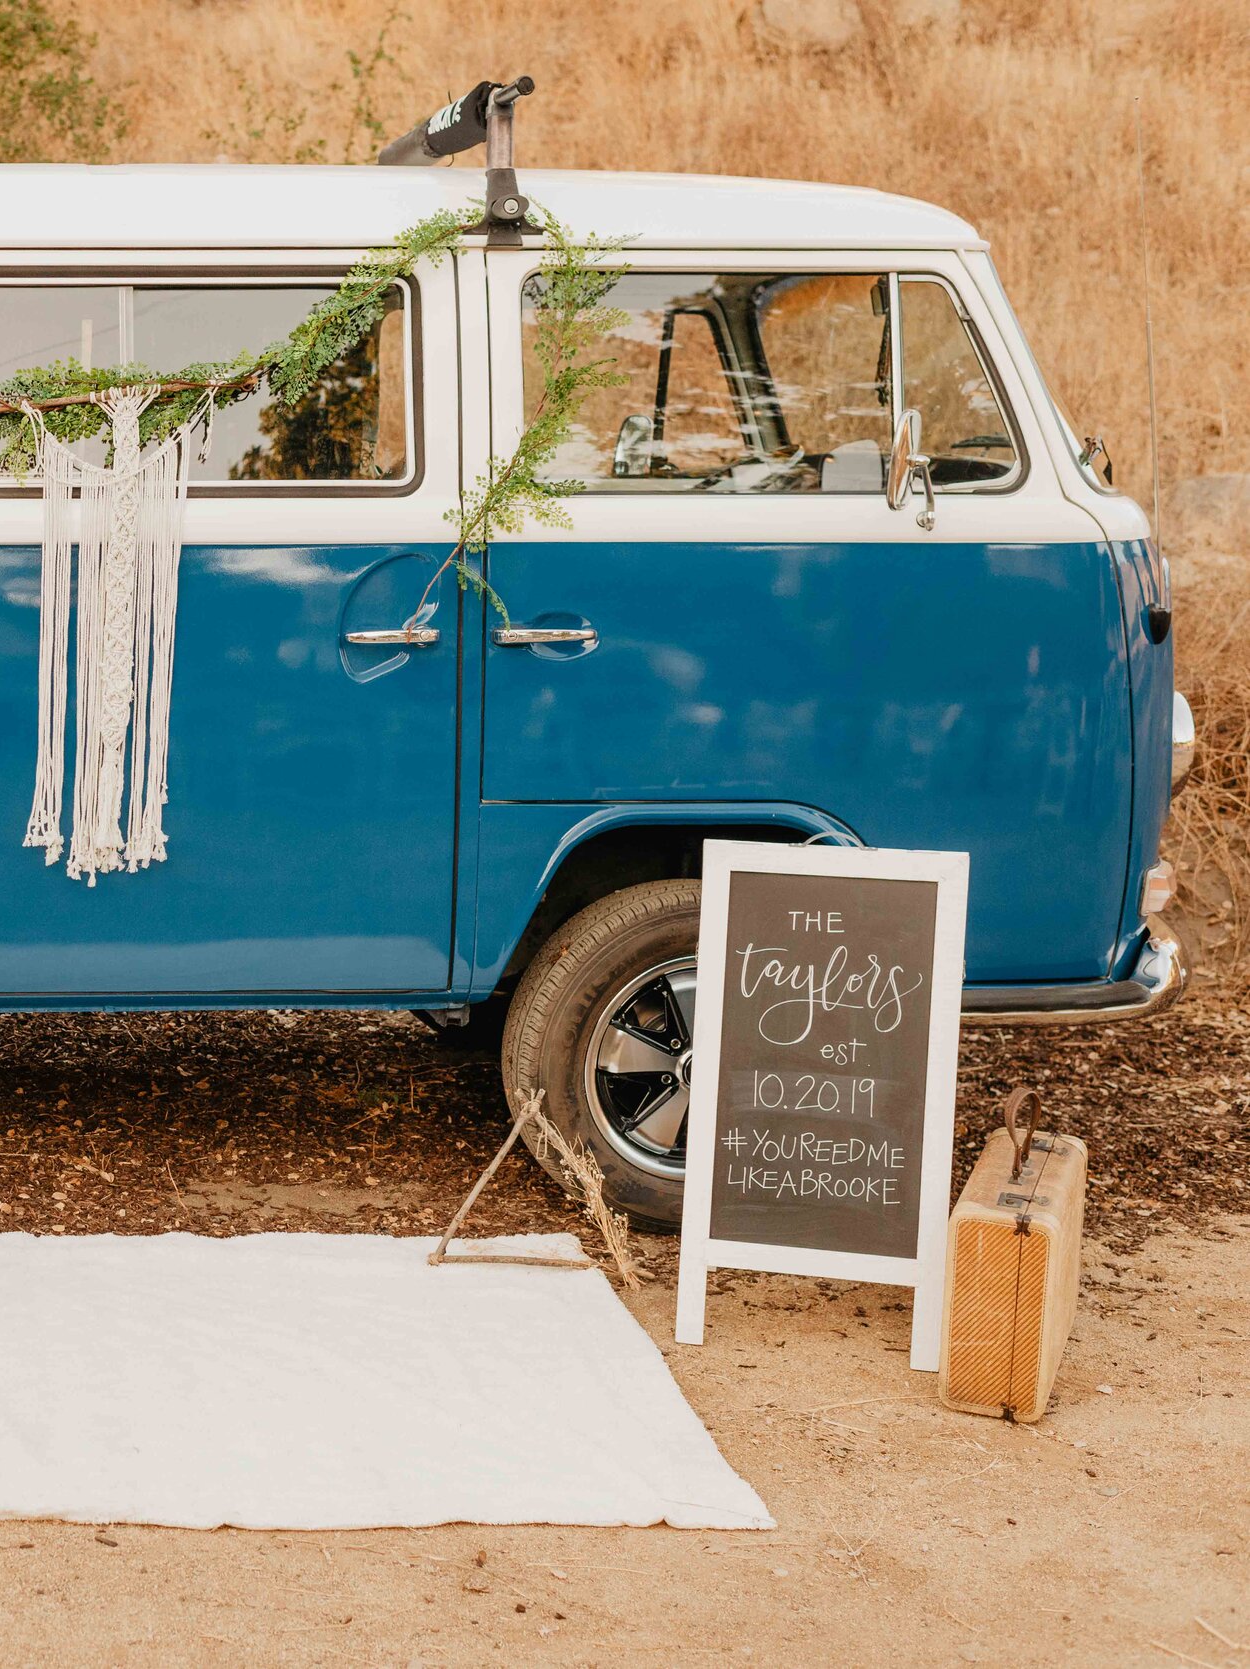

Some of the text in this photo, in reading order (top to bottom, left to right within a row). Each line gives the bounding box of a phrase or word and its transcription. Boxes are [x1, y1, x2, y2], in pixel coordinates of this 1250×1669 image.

[788, 910, 845, 933] THE
[735, 942, 923, 1045] taylors
[753, 1070, 875, 1118] 10.20.19
[721, 1127, 905, 1169] #YOUREEDME
[727, 1164, 901, 1205] LIKEABROOKE
